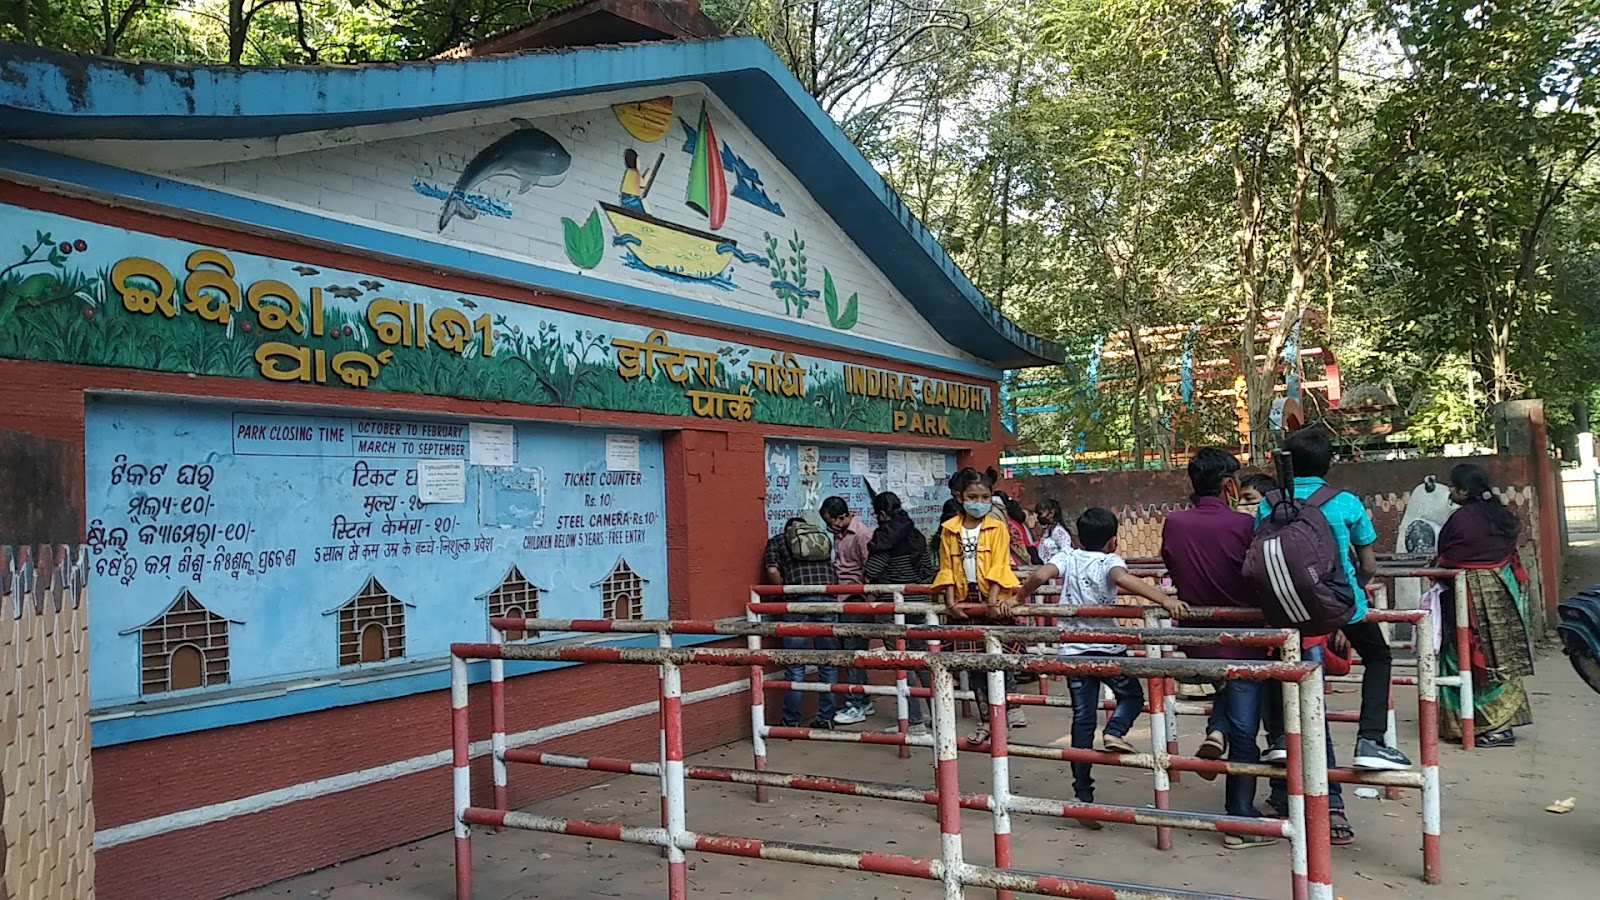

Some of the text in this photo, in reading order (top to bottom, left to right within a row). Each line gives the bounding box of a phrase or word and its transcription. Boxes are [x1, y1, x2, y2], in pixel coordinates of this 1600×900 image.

[254, 340, 394, 387] ପାର୍କ
[844, 364, 987, 412] INDIRA GANDHI
[686, 384, 755, 421] पार्क
[237, 425, 345, 443] PARK CLOSING TIME
[358, 421, 463, 438] OCTOBER TO FEBRUARY
[894, 410, 952, 437] PARK
[358, 440, 396, 454] MARCH
[402, 442, 415, 455] TO
[418, 442, 465, 456] SEPTEMBER
[111, 454, 168, 485] ଟିକଟ
[352, 460, 399, 487] टिकट
[405, 469, 418, 486] घ
[564, 472, 642, 487] TICKET COUNTER
[556, 515, 585, 529] STEEL
[523, 535, 552, 550] CHILDREN
[554, 533, 577, 548] BELOW
[578, 533, 584, 547] 5
[625, 529, 647, 544] ENTRY
